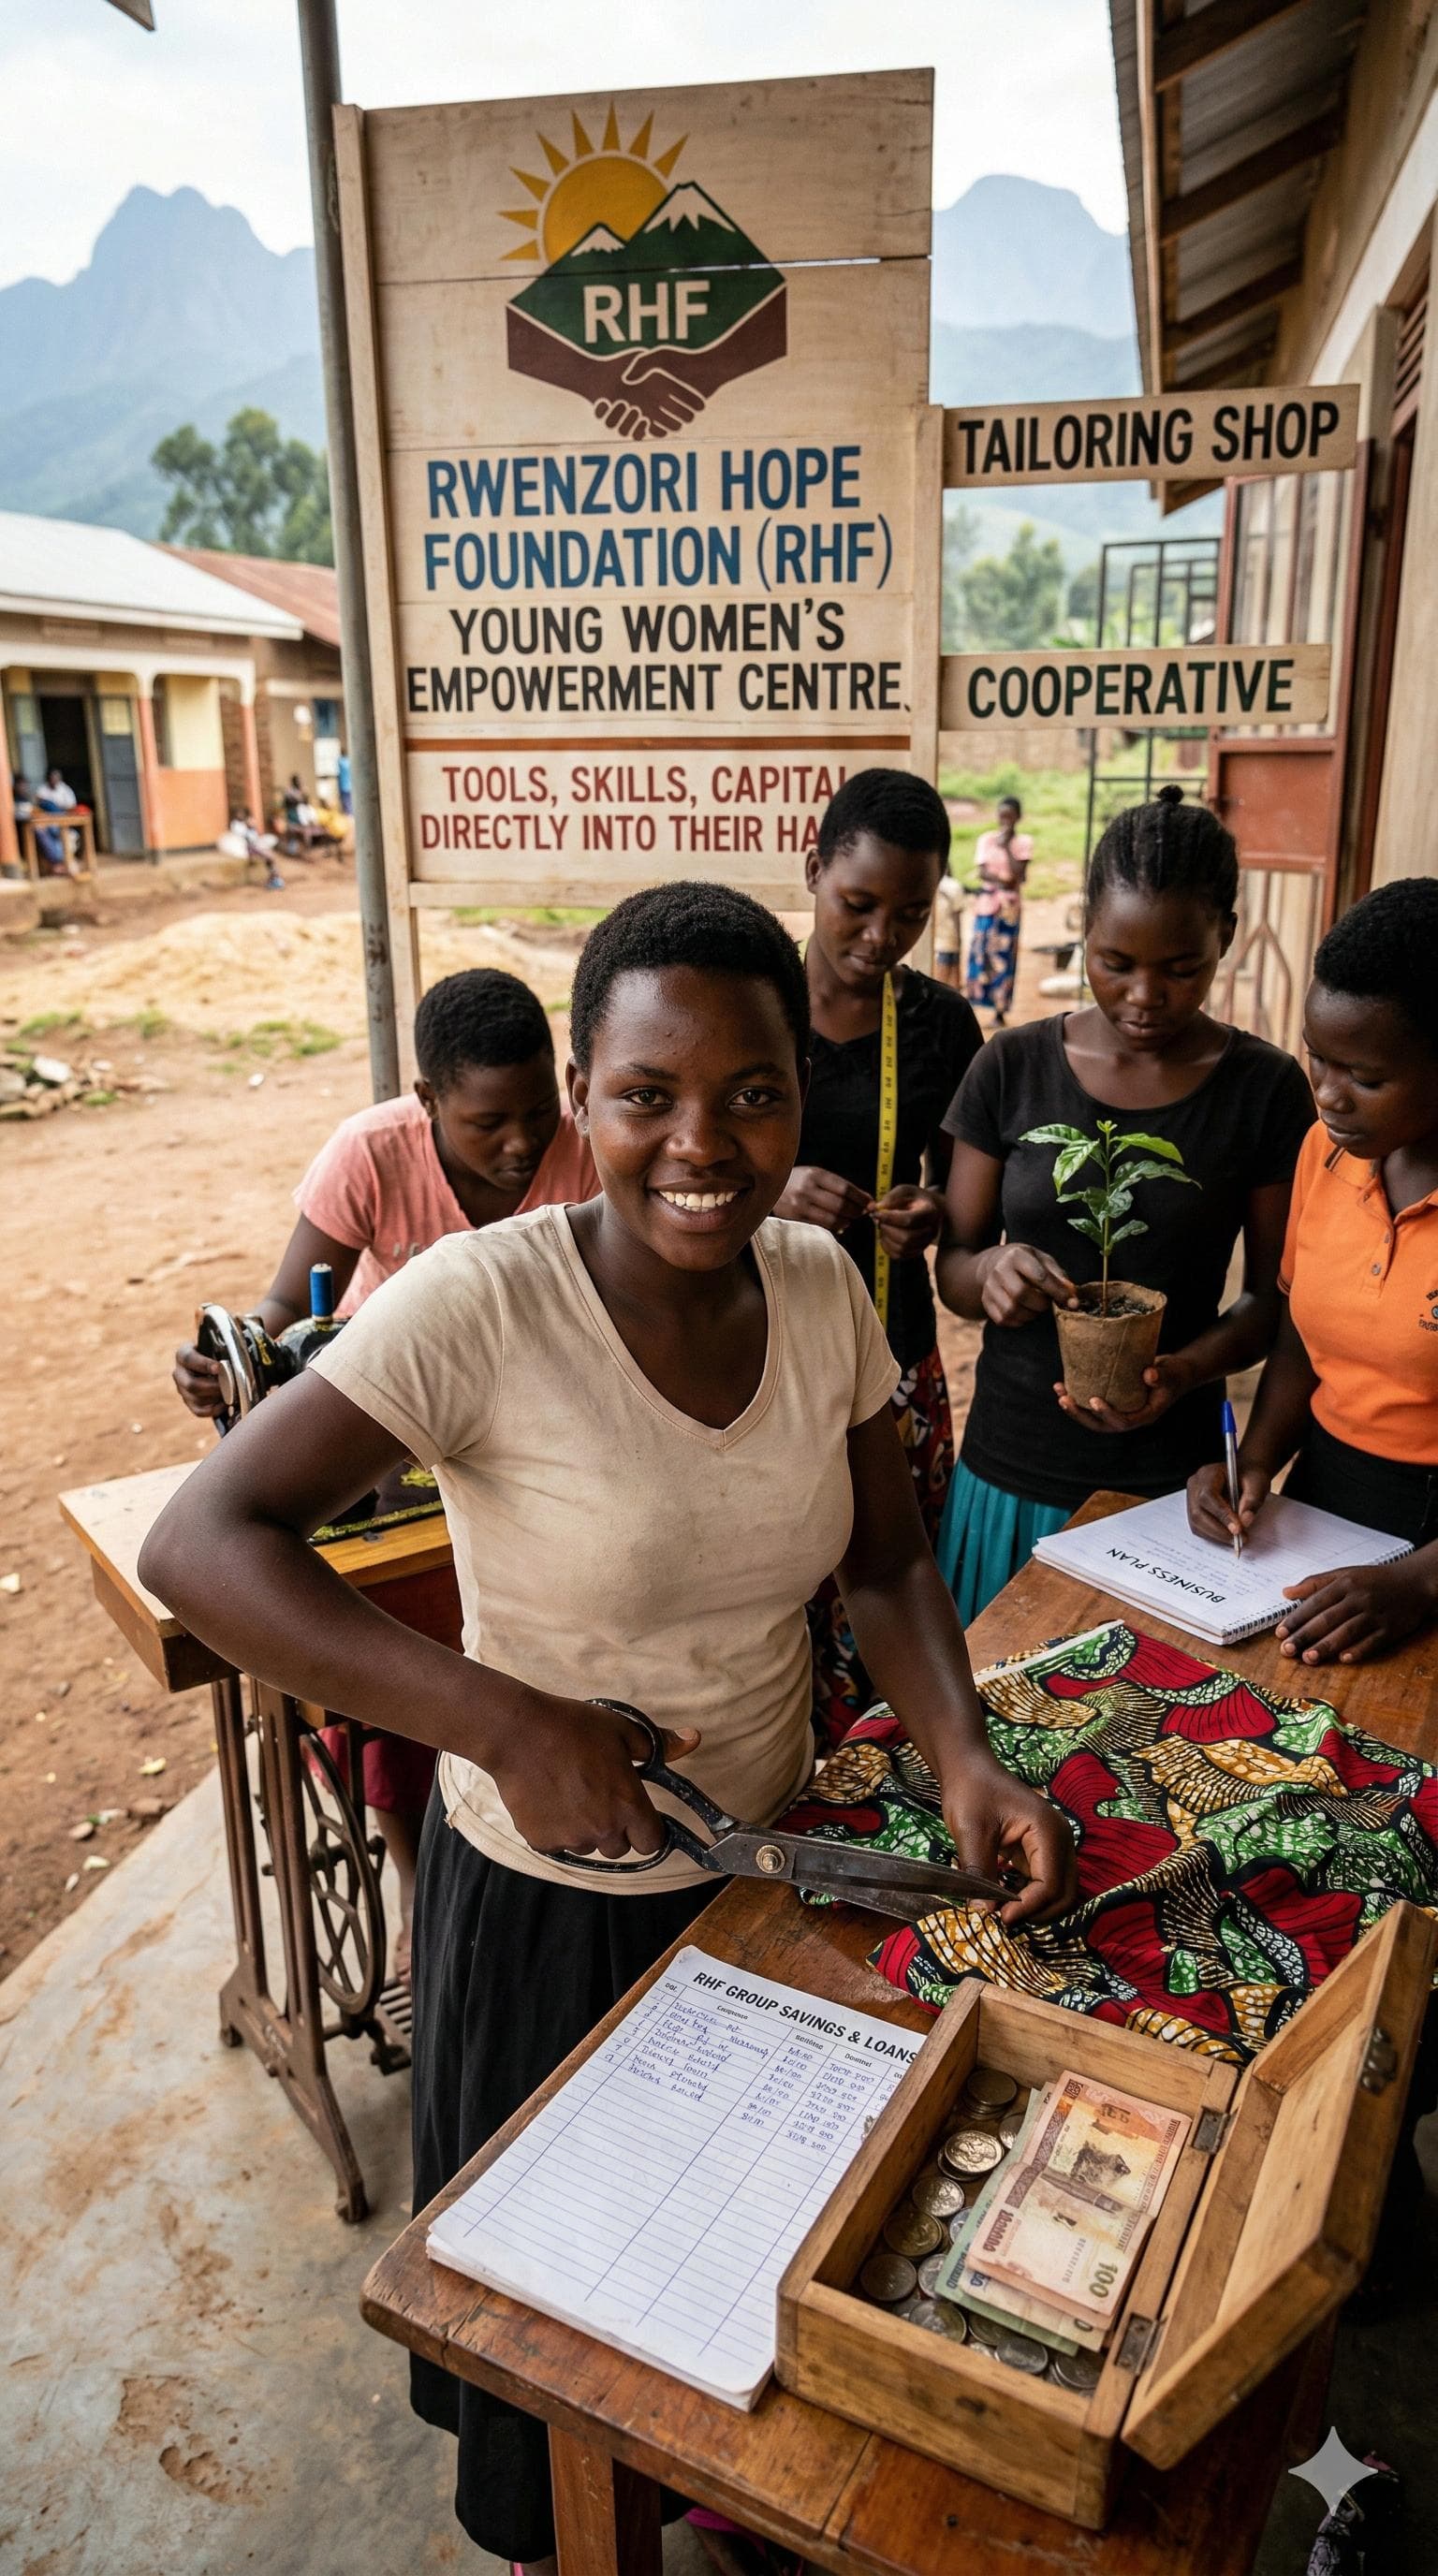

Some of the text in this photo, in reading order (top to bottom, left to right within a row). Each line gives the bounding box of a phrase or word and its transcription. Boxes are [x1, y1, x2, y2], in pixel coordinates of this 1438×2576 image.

[583, 281, 710, 344] RHF
[958, 401, 1340, 475] TAILORING SHOP
[426, 446, 861, 519] RWENZORI HOPE
[424, 514, 892, 592] FOUNDATION (RHF)
[449, 598, 845, 655] YOUNG WOMEN'S
[407, 664, 722, 711] EMPOWERMENT
[967, 658, 1295, 720] COOPERATIVE
[442, 766, 558, 806] TOOLS,
[571, 766, 697, 805] SKILLS,
[421, 814, 569, 850] DIRECTLY
[583, 814, 654, 851] INTO
[669, 815, 764, 852] THEIR
[1107, 1548, 1150, 1570] PLAN
[1148, 1566, 1226, 1603] BUSINESS
[693, 1971, 726, 1992] RHF
[726, 1984, 779, 2012] GROUP
[779, 2005, 847, 2039] SAVINGS
[847, 2030, 862, 2044] &
[1089, 2261, 1119, 2298] 100
